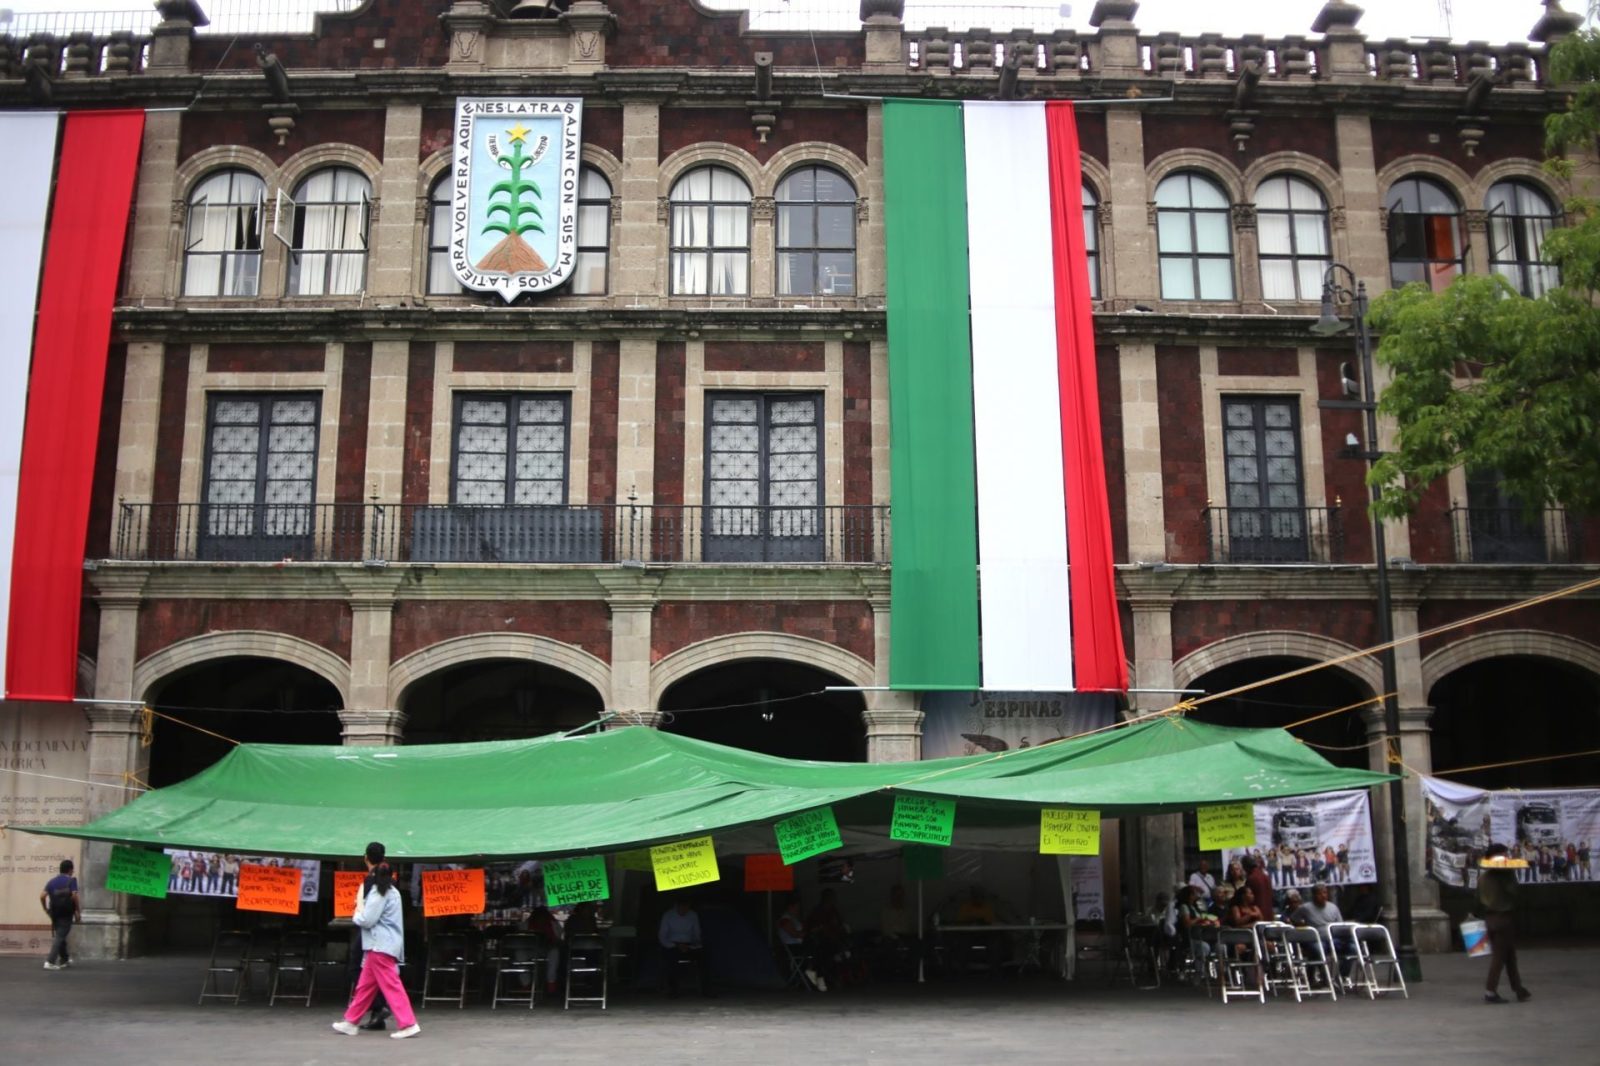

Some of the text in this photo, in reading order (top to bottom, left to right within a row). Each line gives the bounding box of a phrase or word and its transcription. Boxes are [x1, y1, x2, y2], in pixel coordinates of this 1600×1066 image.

[507, 103, 527, 113] LA
[529, 102, 577, 160] TRABAJAN
[455, 159, 468, 233] VOLVERA
[564, 170, 575, 203] CON
[562, 215, 574, 244] SUS
[453, 238, 487, 287] TIERRA
[519, 253, 573, 288] MANOS
[488, 276, 509, 288] LA
[983, 700, 1062, 718] ESPINAS
[424, 882, 468, 896] HAMBRE
[546, 878, 604, 896] HUELGA DE
